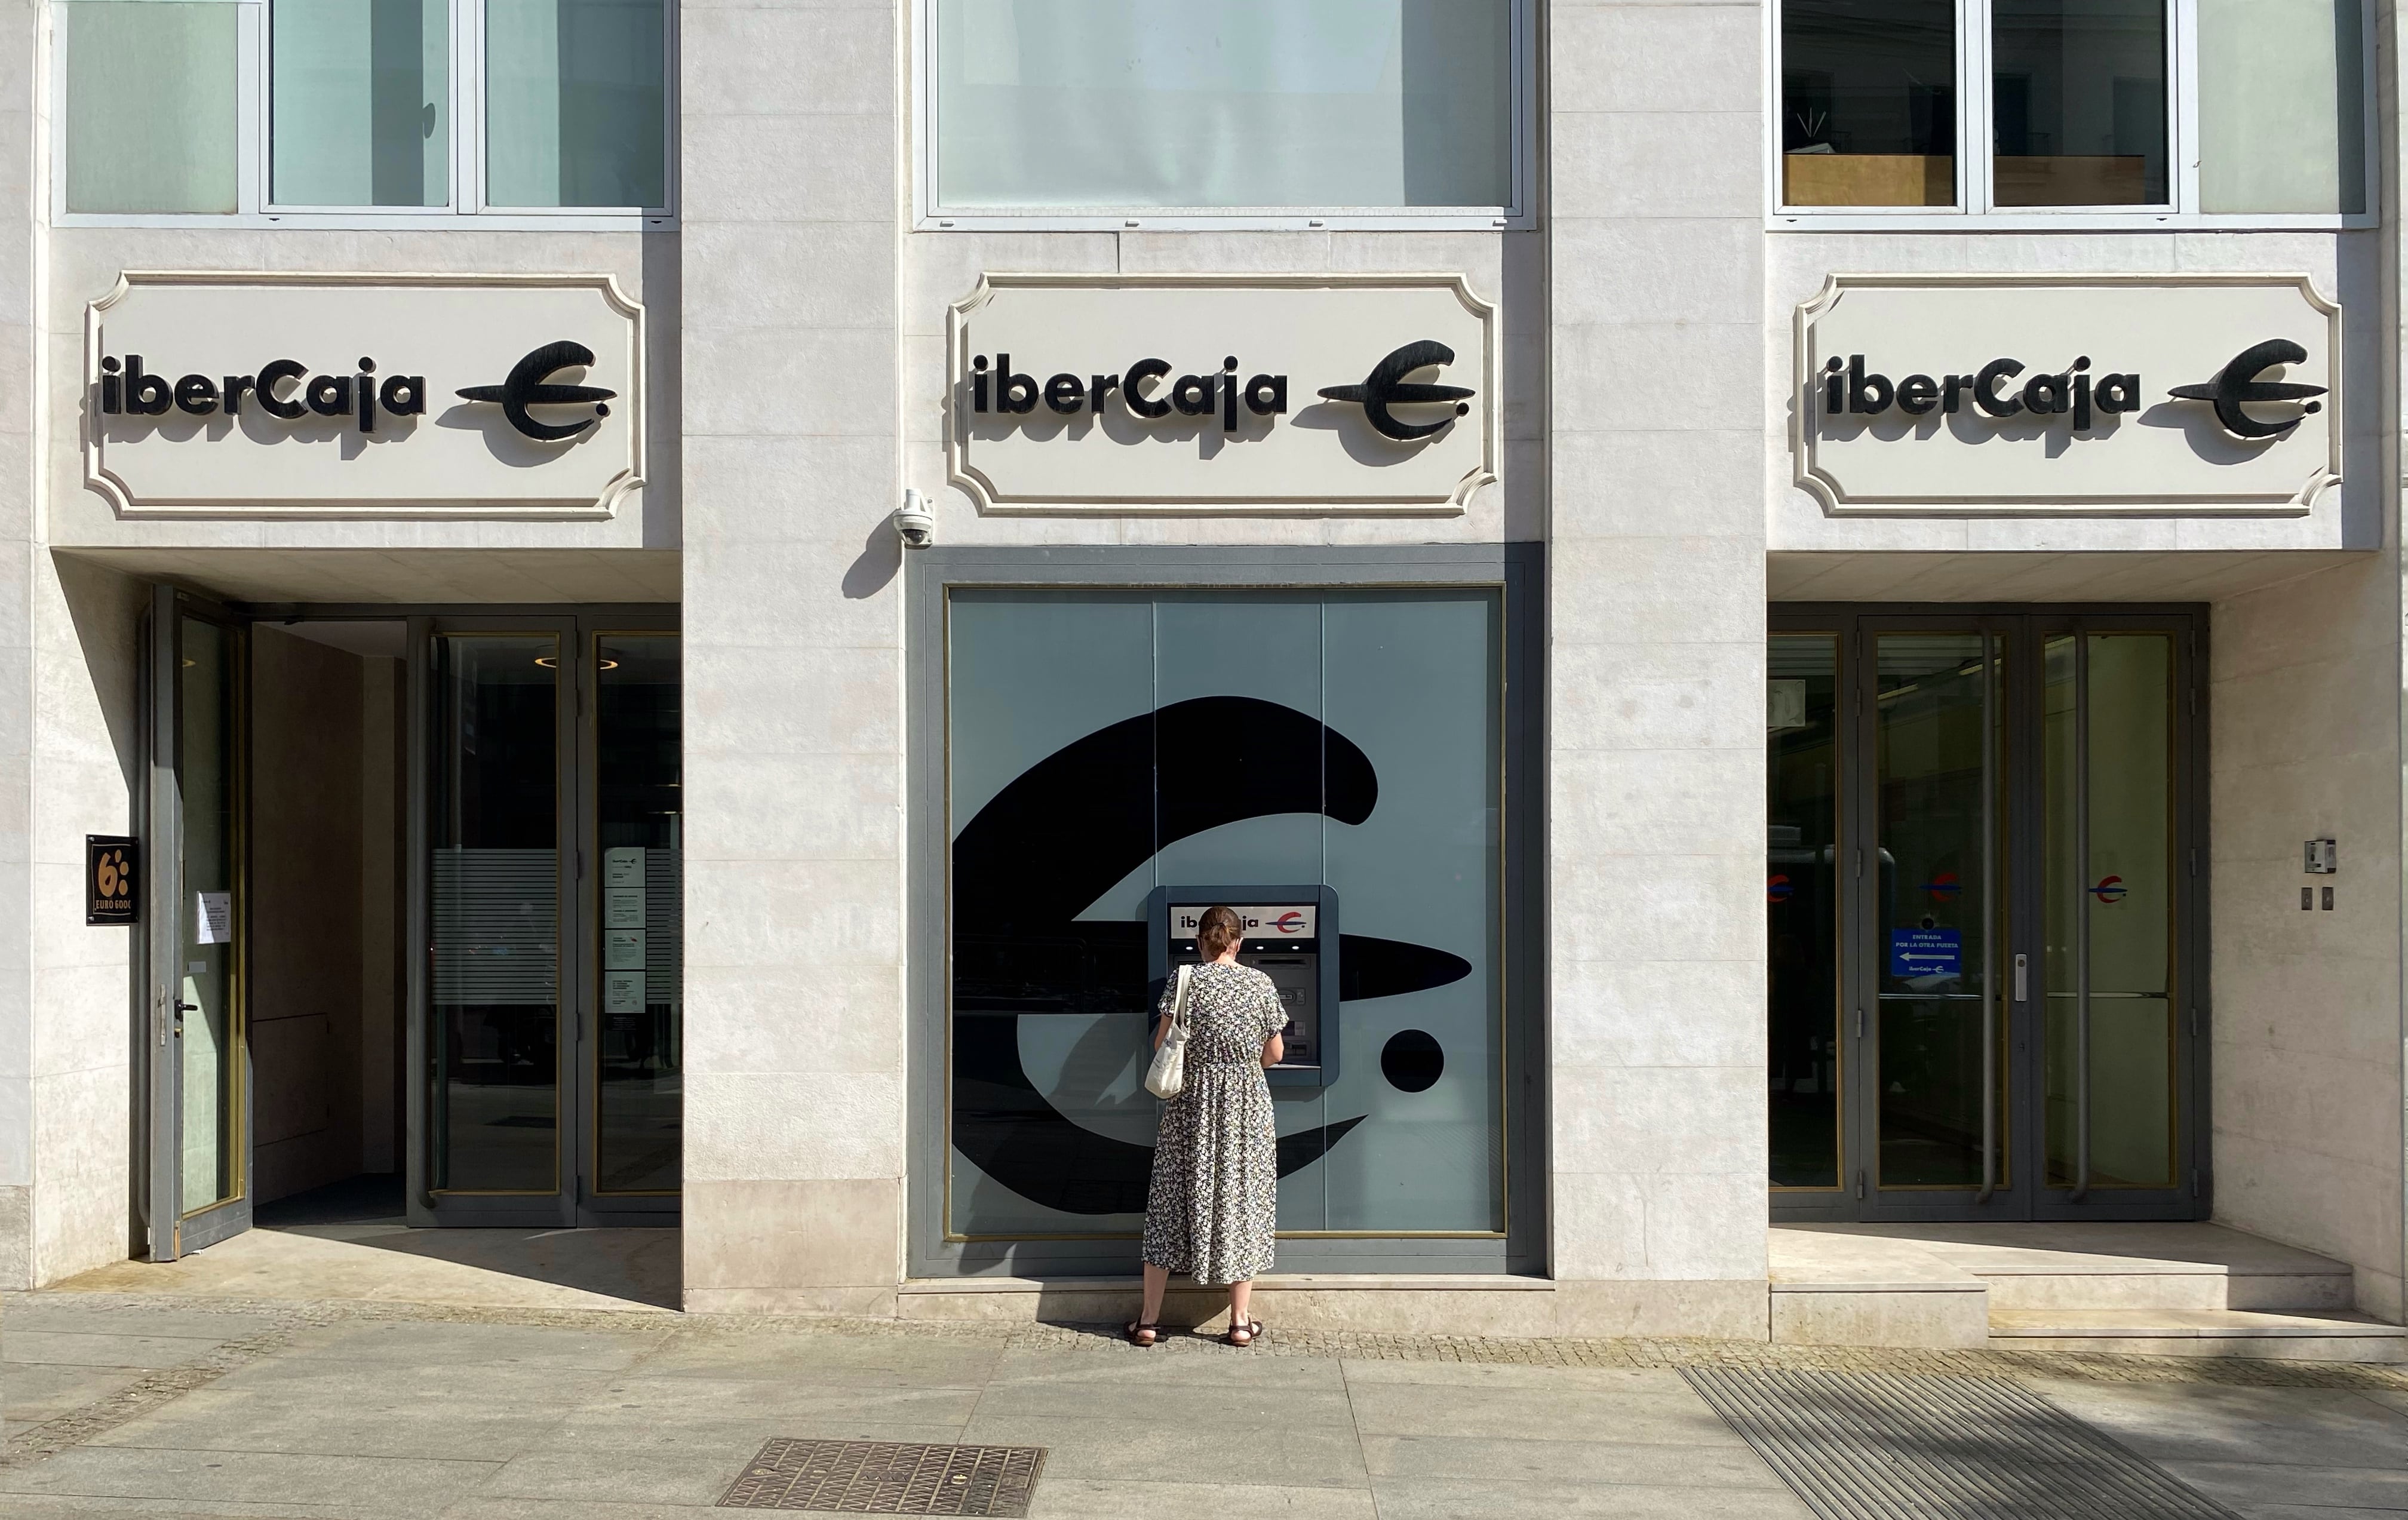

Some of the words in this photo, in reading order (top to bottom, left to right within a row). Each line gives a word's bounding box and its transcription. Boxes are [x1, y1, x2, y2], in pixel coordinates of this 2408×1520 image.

[102, 354, 426, 434] iberCaja
[972, 353, 1288, 432] iberCaja
[1825, 354, 2141, 431] iberCaja
[96, 899, 113, 909] EURO
